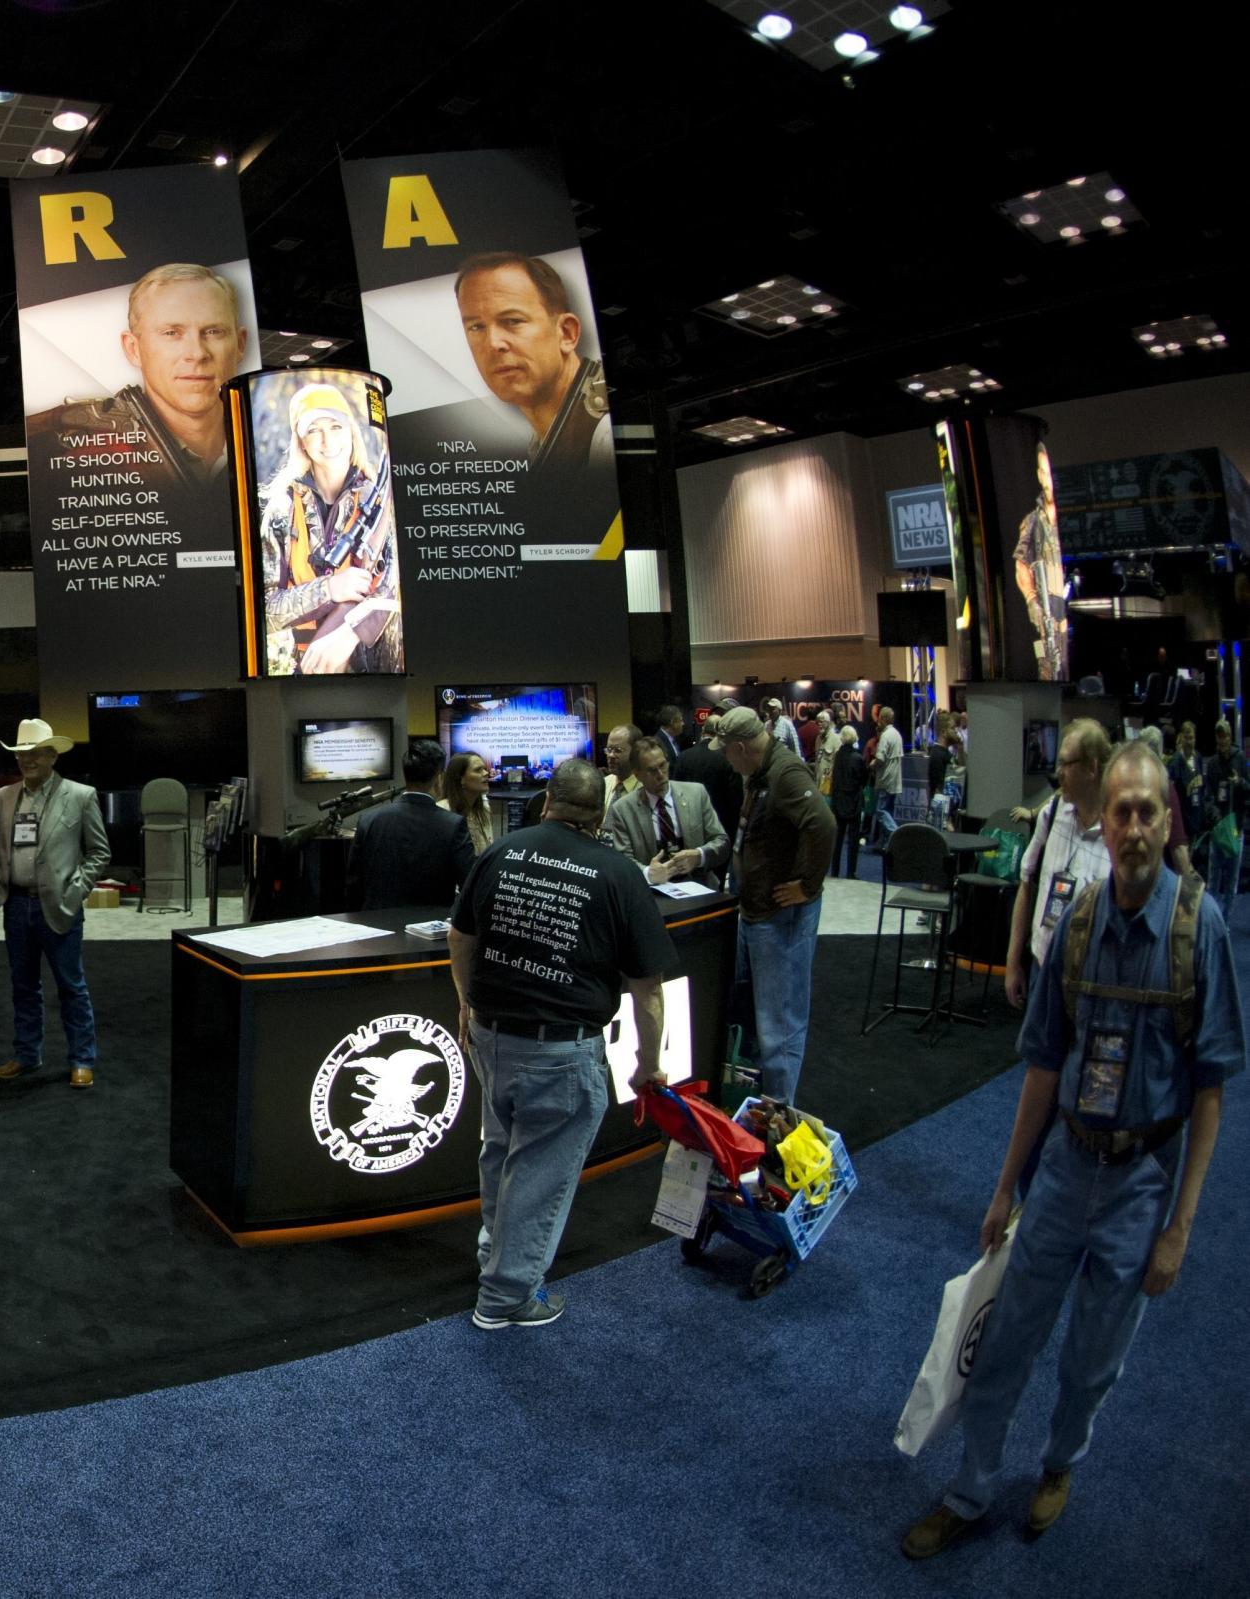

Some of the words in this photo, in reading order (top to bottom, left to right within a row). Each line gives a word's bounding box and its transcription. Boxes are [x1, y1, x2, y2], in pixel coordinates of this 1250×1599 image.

[382, 174, 459, 249] A
[39, 191, 127, 265] R
[63, 431, 147, 448] "WHETHER
[437, 441, 477, 453] "NRA
[50, 456, 75, 470] IT'S
[79, 451, 163, 467] SHOOTING,
[430, 462, 450, 475] OF
[455, 460, 529, 473] FREEDOM
[71, 472, 144, 488] HUNTING,
[407, 482, 480, 496] MEMBERS
[485, 481, 516, 494] ARE
[58, 494, 131, 509] TRAINING
[136, 491, 159, 504] OR
[423, 503, 504, 517] ESSENTIAL
[897, 501, 945, 530] NRA
[52, 512, 169, 530] SELF-DEFENSE,
[405, 526, 426, 539] TO
[430, 523, 525, 538] PRESERVING
[903, 529, 944, 549] NEWS
[41, 539, 70, 552] ALL
[74, 536, 108, 550] GUN
[112, 532, 182, 547] OWNERS
[418, 546, 448, 559] THE
[452, 545, 515, 558] SECOND
[57, 557, 98, 571] HAVE
[102, 556, 114, 568] A
[118, 553, 168, 567] PLACE
[418, 565, 523, 581] AMENDMENT."
[66, 579, 87, 592] AT
[89, 576, 119, 589] THE
[123, 574, 165, 588] NRA."
[505, 849, 526, 860] 2nd
[529, 851, 598, 878] Amendment
[499, 881, 519, 894] being
[521, 887, 557, 902] necessary
[569, 897, 583, 908] the
[509, 873, 525, 881] well
[526, 876, 560, 890] regulated
[562, 882, 591, 900] Militia,
[495, 893, 525, 906] security
[527, 898, 535, 906] of
[541, 901, 557, 912] free
[558, 906, 581, 920] State,
[494, 902, 505, 911] the
[507, 906, 526, 916] right
[527, 910, 535, 918] of
[536, 911, 549, 921] the
[551, 917, 579, 930] people
[491, 923, 507, 933] shall
[508, 927, 519, 935] not
[521, 929, 531, 939] be
[500, 915, 518, 926] keep
[520, 919, 531, 929] and
[533, 922, 551, 934] bear
[552, 928, 578, 942] Arms,
[484, 947, 509, 965] BILL
[511, 957, 523, 969] of
[523, 960, 574, 984] RIGHTS
[551, 954, 566, 963] 1791
[376, 1017, 416, 1031] RIFLE
[434, 1033, 463, 1123] ASSOCIATION
[313, 1053, 343, 1132] NATIONAL
[354, 1157, 371, 1168] OF
[371, 1149, 420, 1170] AMERICA
